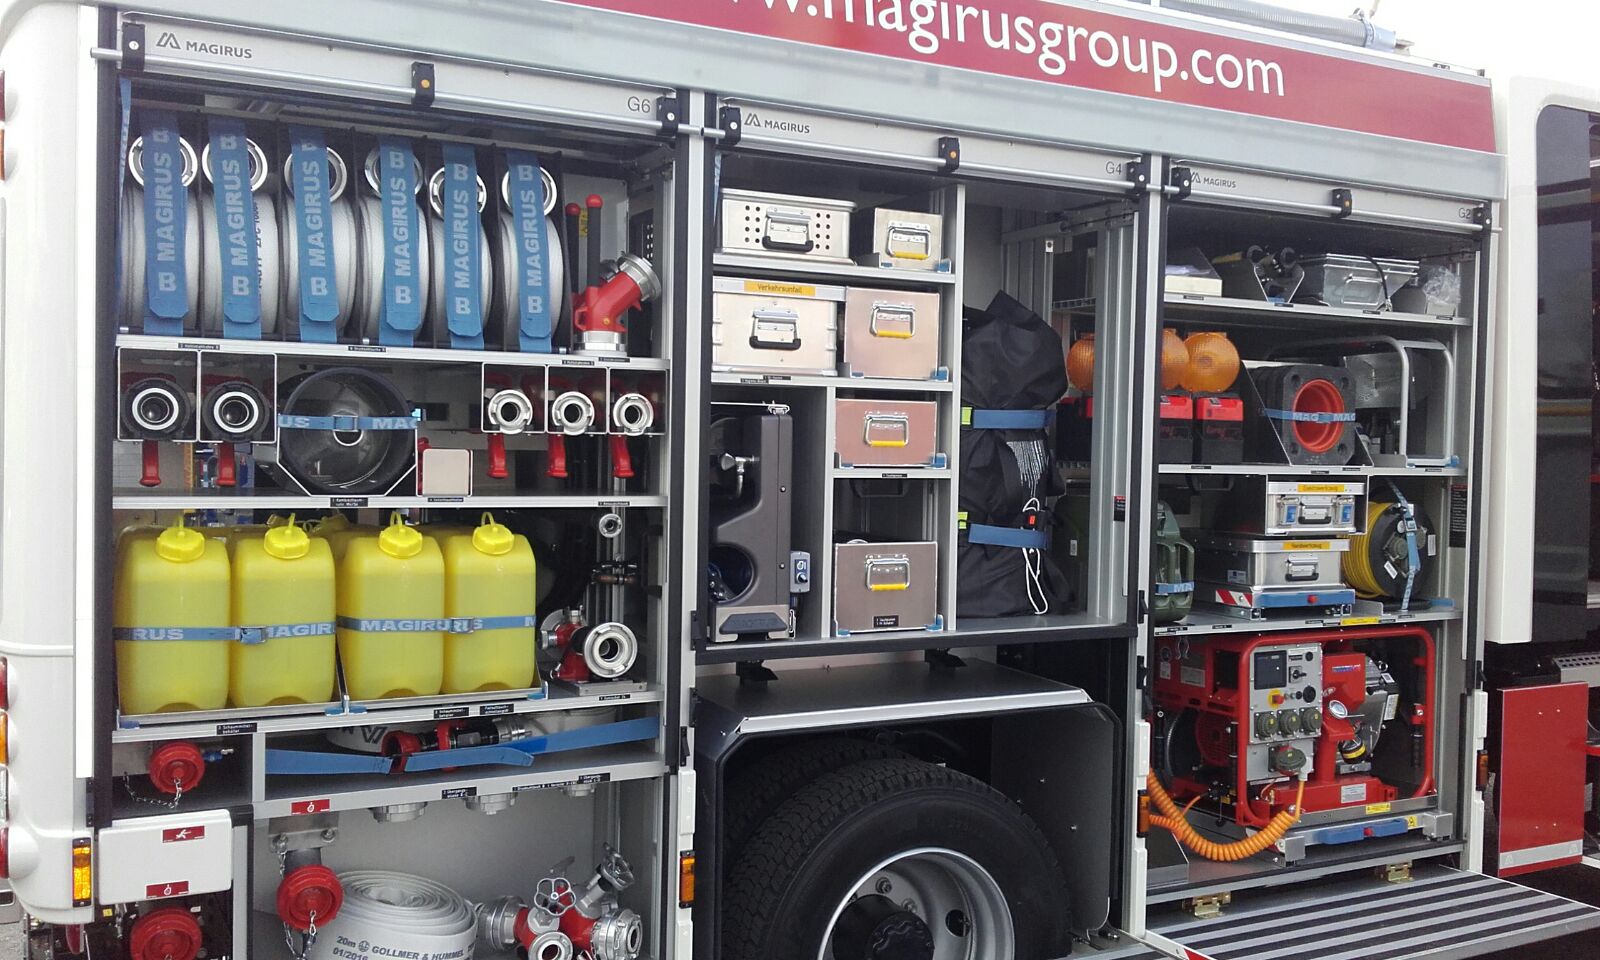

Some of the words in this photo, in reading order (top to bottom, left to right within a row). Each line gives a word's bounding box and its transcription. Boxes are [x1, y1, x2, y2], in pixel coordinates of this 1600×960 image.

[186, 41, 253, 59] MAGIRUS
[627, 96, 651, 113] G6
[764, 120, 811, 134] MAGIRUS
[1105, 161, 1122, 175] G4
[1203, 177, 1237, 189] MAGIRUS
[153, 152, 176, 263] MAGIRUS
[222, 159, 249, 267] MAGIRUS
[302, 160, 326, 267] MAGIRUS
[1458, 207, 1472, 220] G2
[390, 177, 412, 277] MAGIRUS
[453, 189, 471, 289] MAGIRUS
[520, 189, 543, 287] MAGIRUS
[336, 936, 357, 949] 20m
[371, 946, 420, 960] GOLLMER
